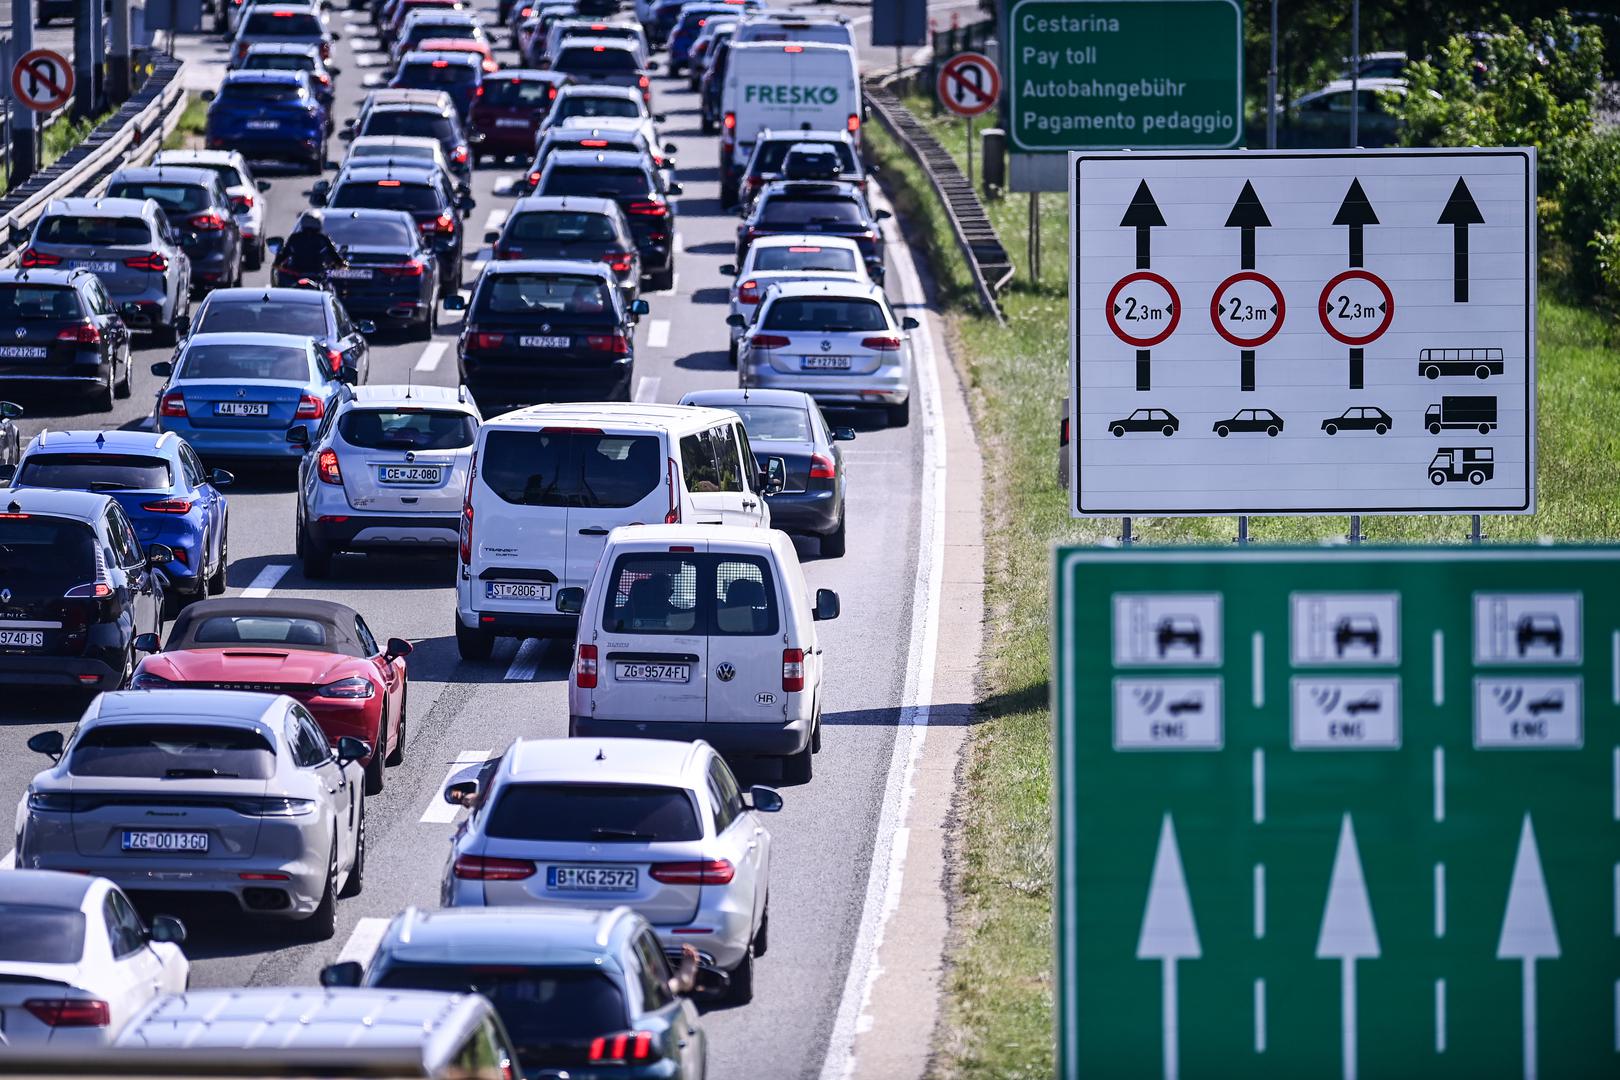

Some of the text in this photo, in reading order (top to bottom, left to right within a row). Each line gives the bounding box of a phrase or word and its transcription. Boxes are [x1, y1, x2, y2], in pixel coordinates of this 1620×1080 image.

[1022, 14, 1120, 33] Cestarina
[1022, 46, 1097, 69] Pay toll
[744, 84, 839, 104] FRESKO
[1022, 78, 1187, 101] Autobahngebühr
[1023, 111, 1233, 134] Pagamento pedaggio
[243, 403, 265, 414] 9751
[387, 469, 400, 479] CE
[494, 584, 505, 595] ST
[624, 665, 638, 677] ZG
[758, 694, 774, 703] HR
[132, 833, 148, 848] ZG
[557, 869, 634, 886] B KG 2572
